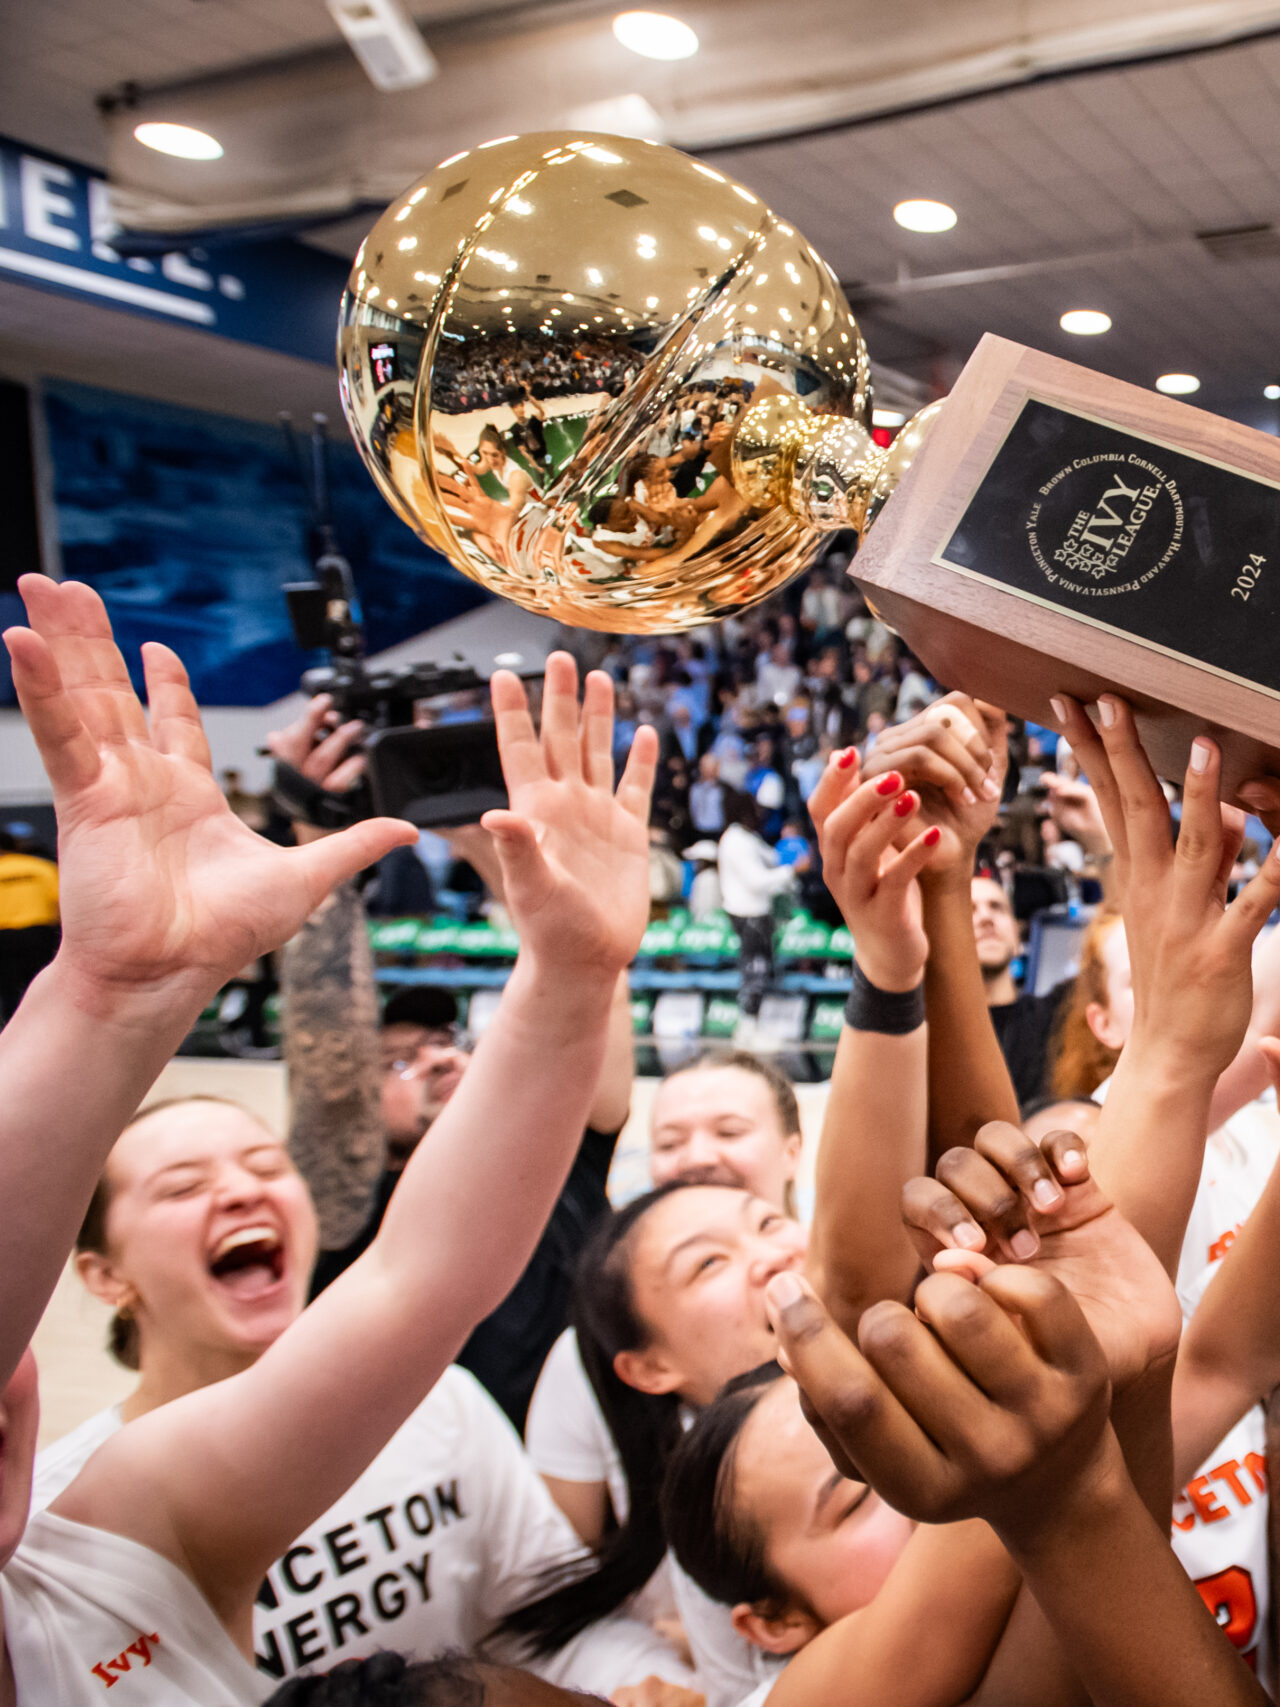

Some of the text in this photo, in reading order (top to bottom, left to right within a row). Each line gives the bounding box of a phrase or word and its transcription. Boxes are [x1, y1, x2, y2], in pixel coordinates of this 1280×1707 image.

[1025, 453, 1184, 596] BROWN COLUMBIA CORNELL DARTMOUTH HARVARD PENNSYLVANIA PRINCETON YALE
[1068, 509, 1090, 538] THE
[1080, 473, 1141, 551] IVY
[1230, 552, 1268, 602] 2024
[90, 1631, 160, 1689] Ivy
